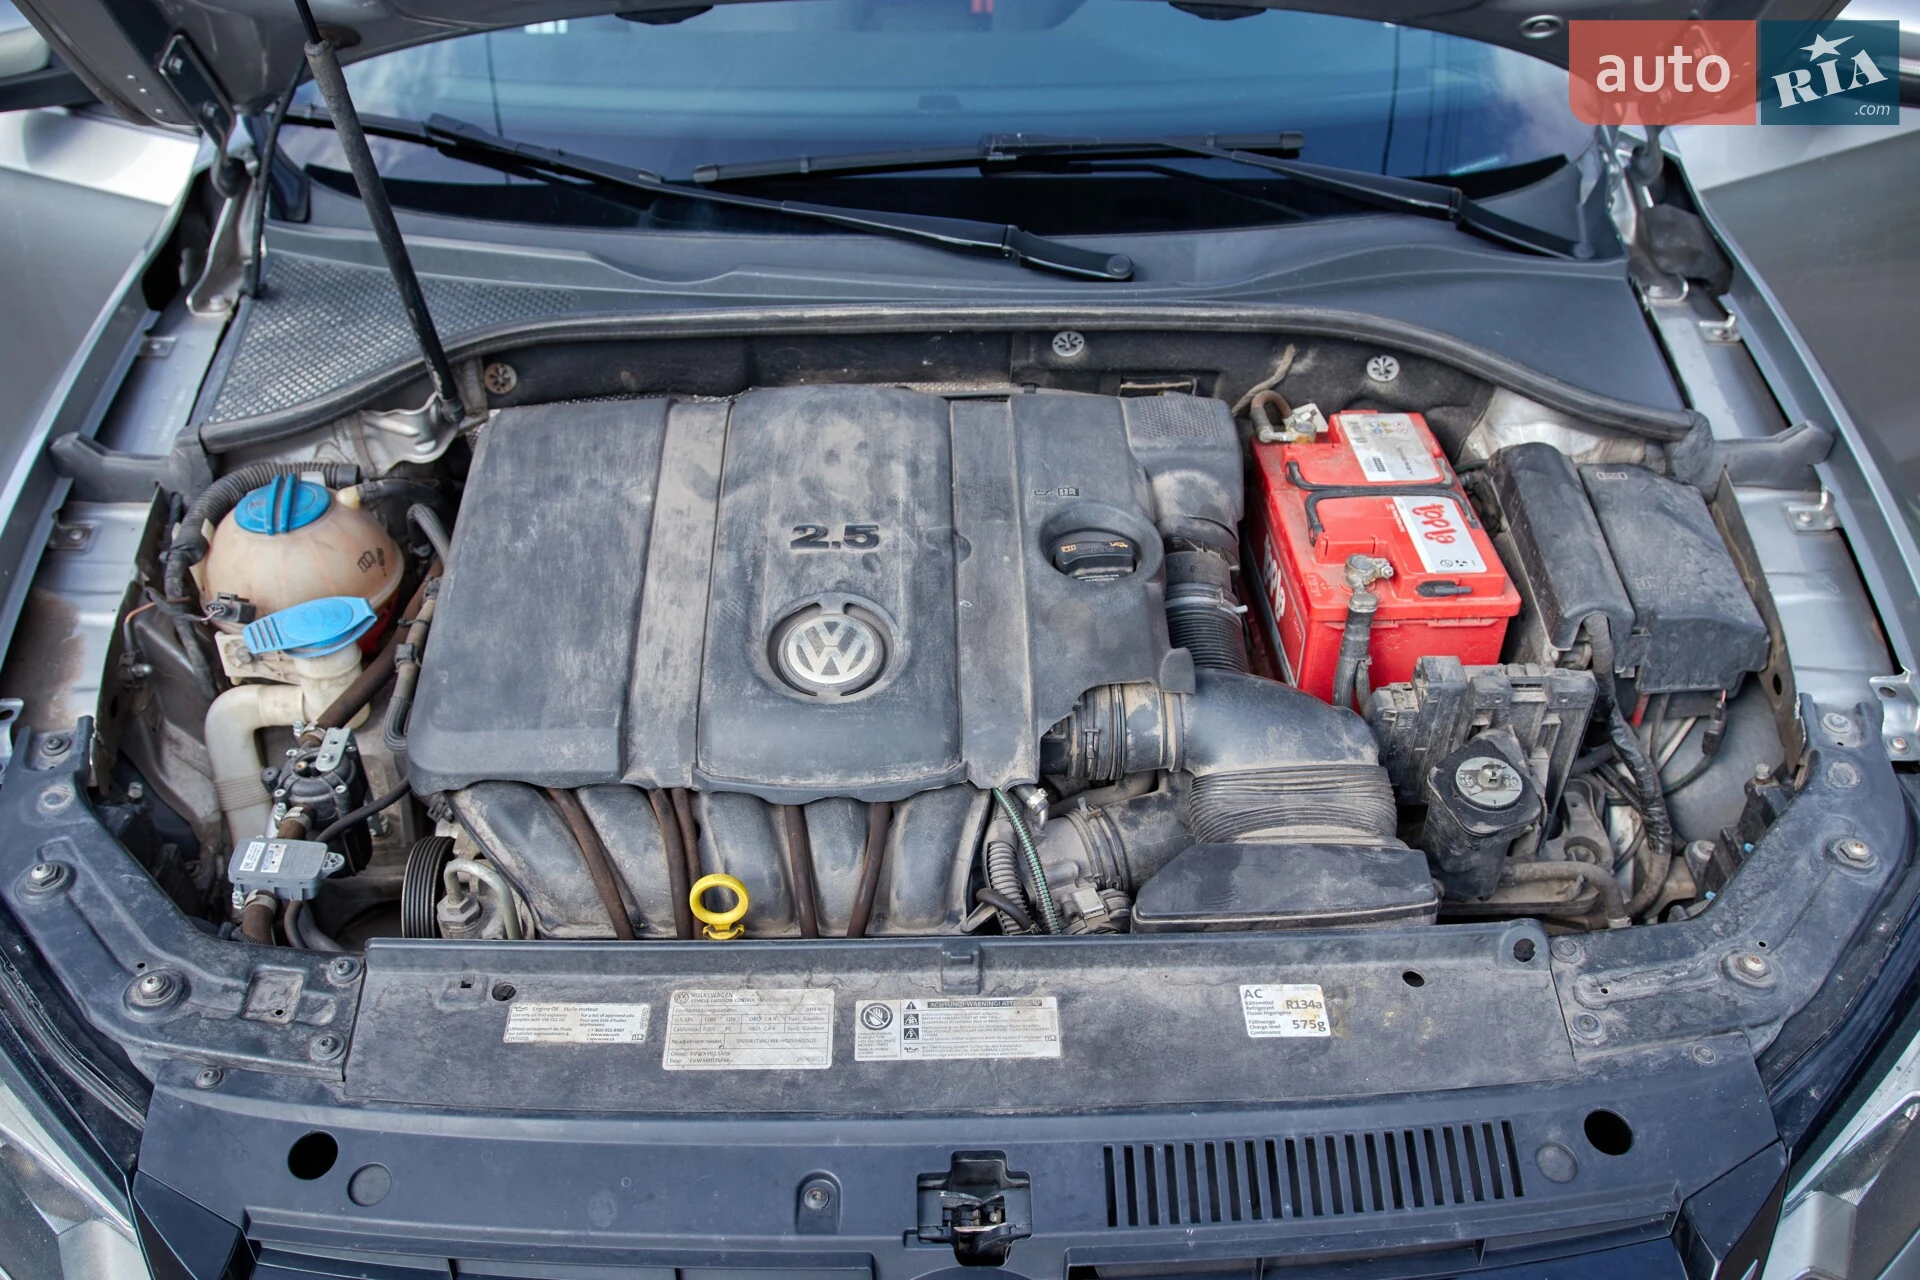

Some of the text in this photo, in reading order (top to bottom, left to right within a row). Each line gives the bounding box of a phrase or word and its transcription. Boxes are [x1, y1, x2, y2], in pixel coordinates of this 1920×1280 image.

[790, 524, 880, 550] 2.5
[1244, 988, 1263, 999] AC
[1285, 999, 1323, 1010] R134a
[1292, 1019, 1327, 1033] 575g
